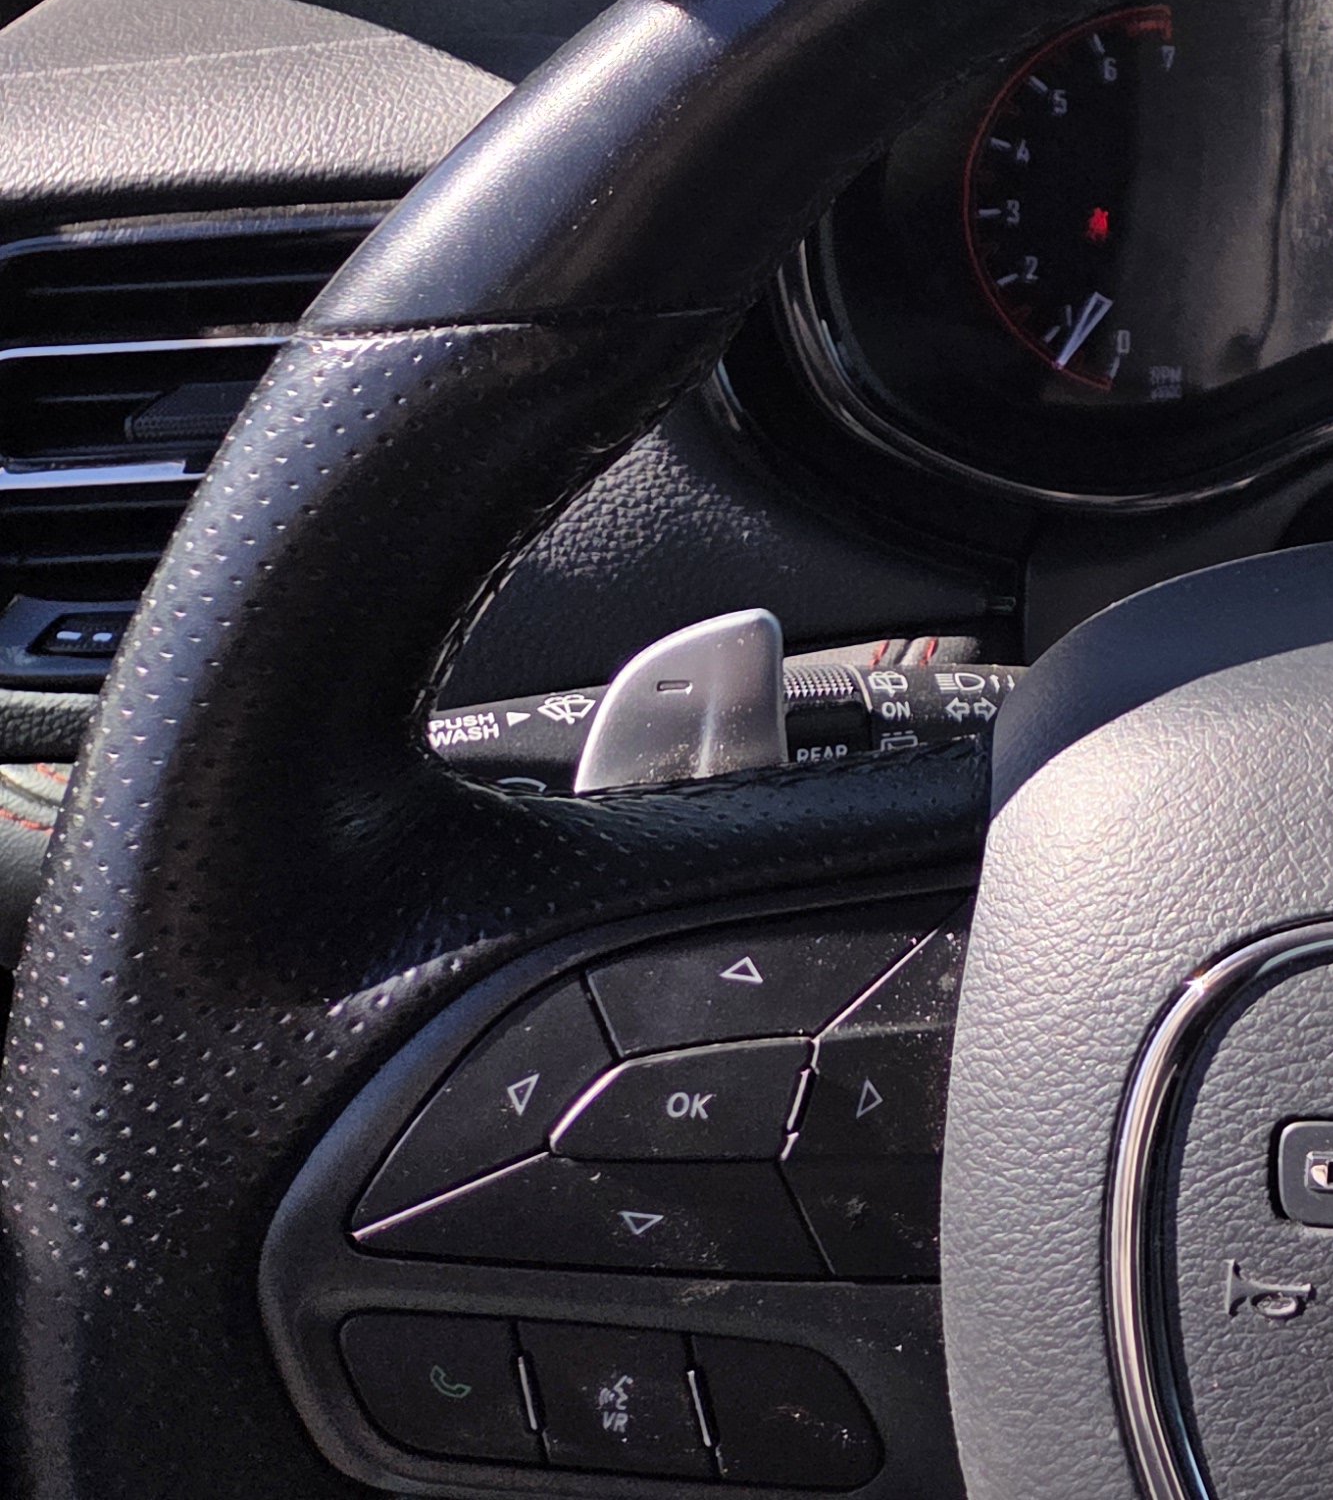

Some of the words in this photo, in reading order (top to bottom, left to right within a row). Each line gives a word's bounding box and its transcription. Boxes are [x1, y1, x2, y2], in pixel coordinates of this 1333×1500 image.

[1103, 57, 1118, 82] 6
[1052, 89, 1068, 116] 5
[1015, 140, 1031, 163] 4
[1006, 200, 1021, 224] 3
[1024, 255, 1040, 281] 2
[1116, 329, 1131, 353] 0
[428, 711, 496, 734] PUSH
[881, 702, 911, 719] ON
[428, 724, 500, 748] WASH
[665, 1093, 717, 1120] OK
[601, 1411, 629, 1432] VR
